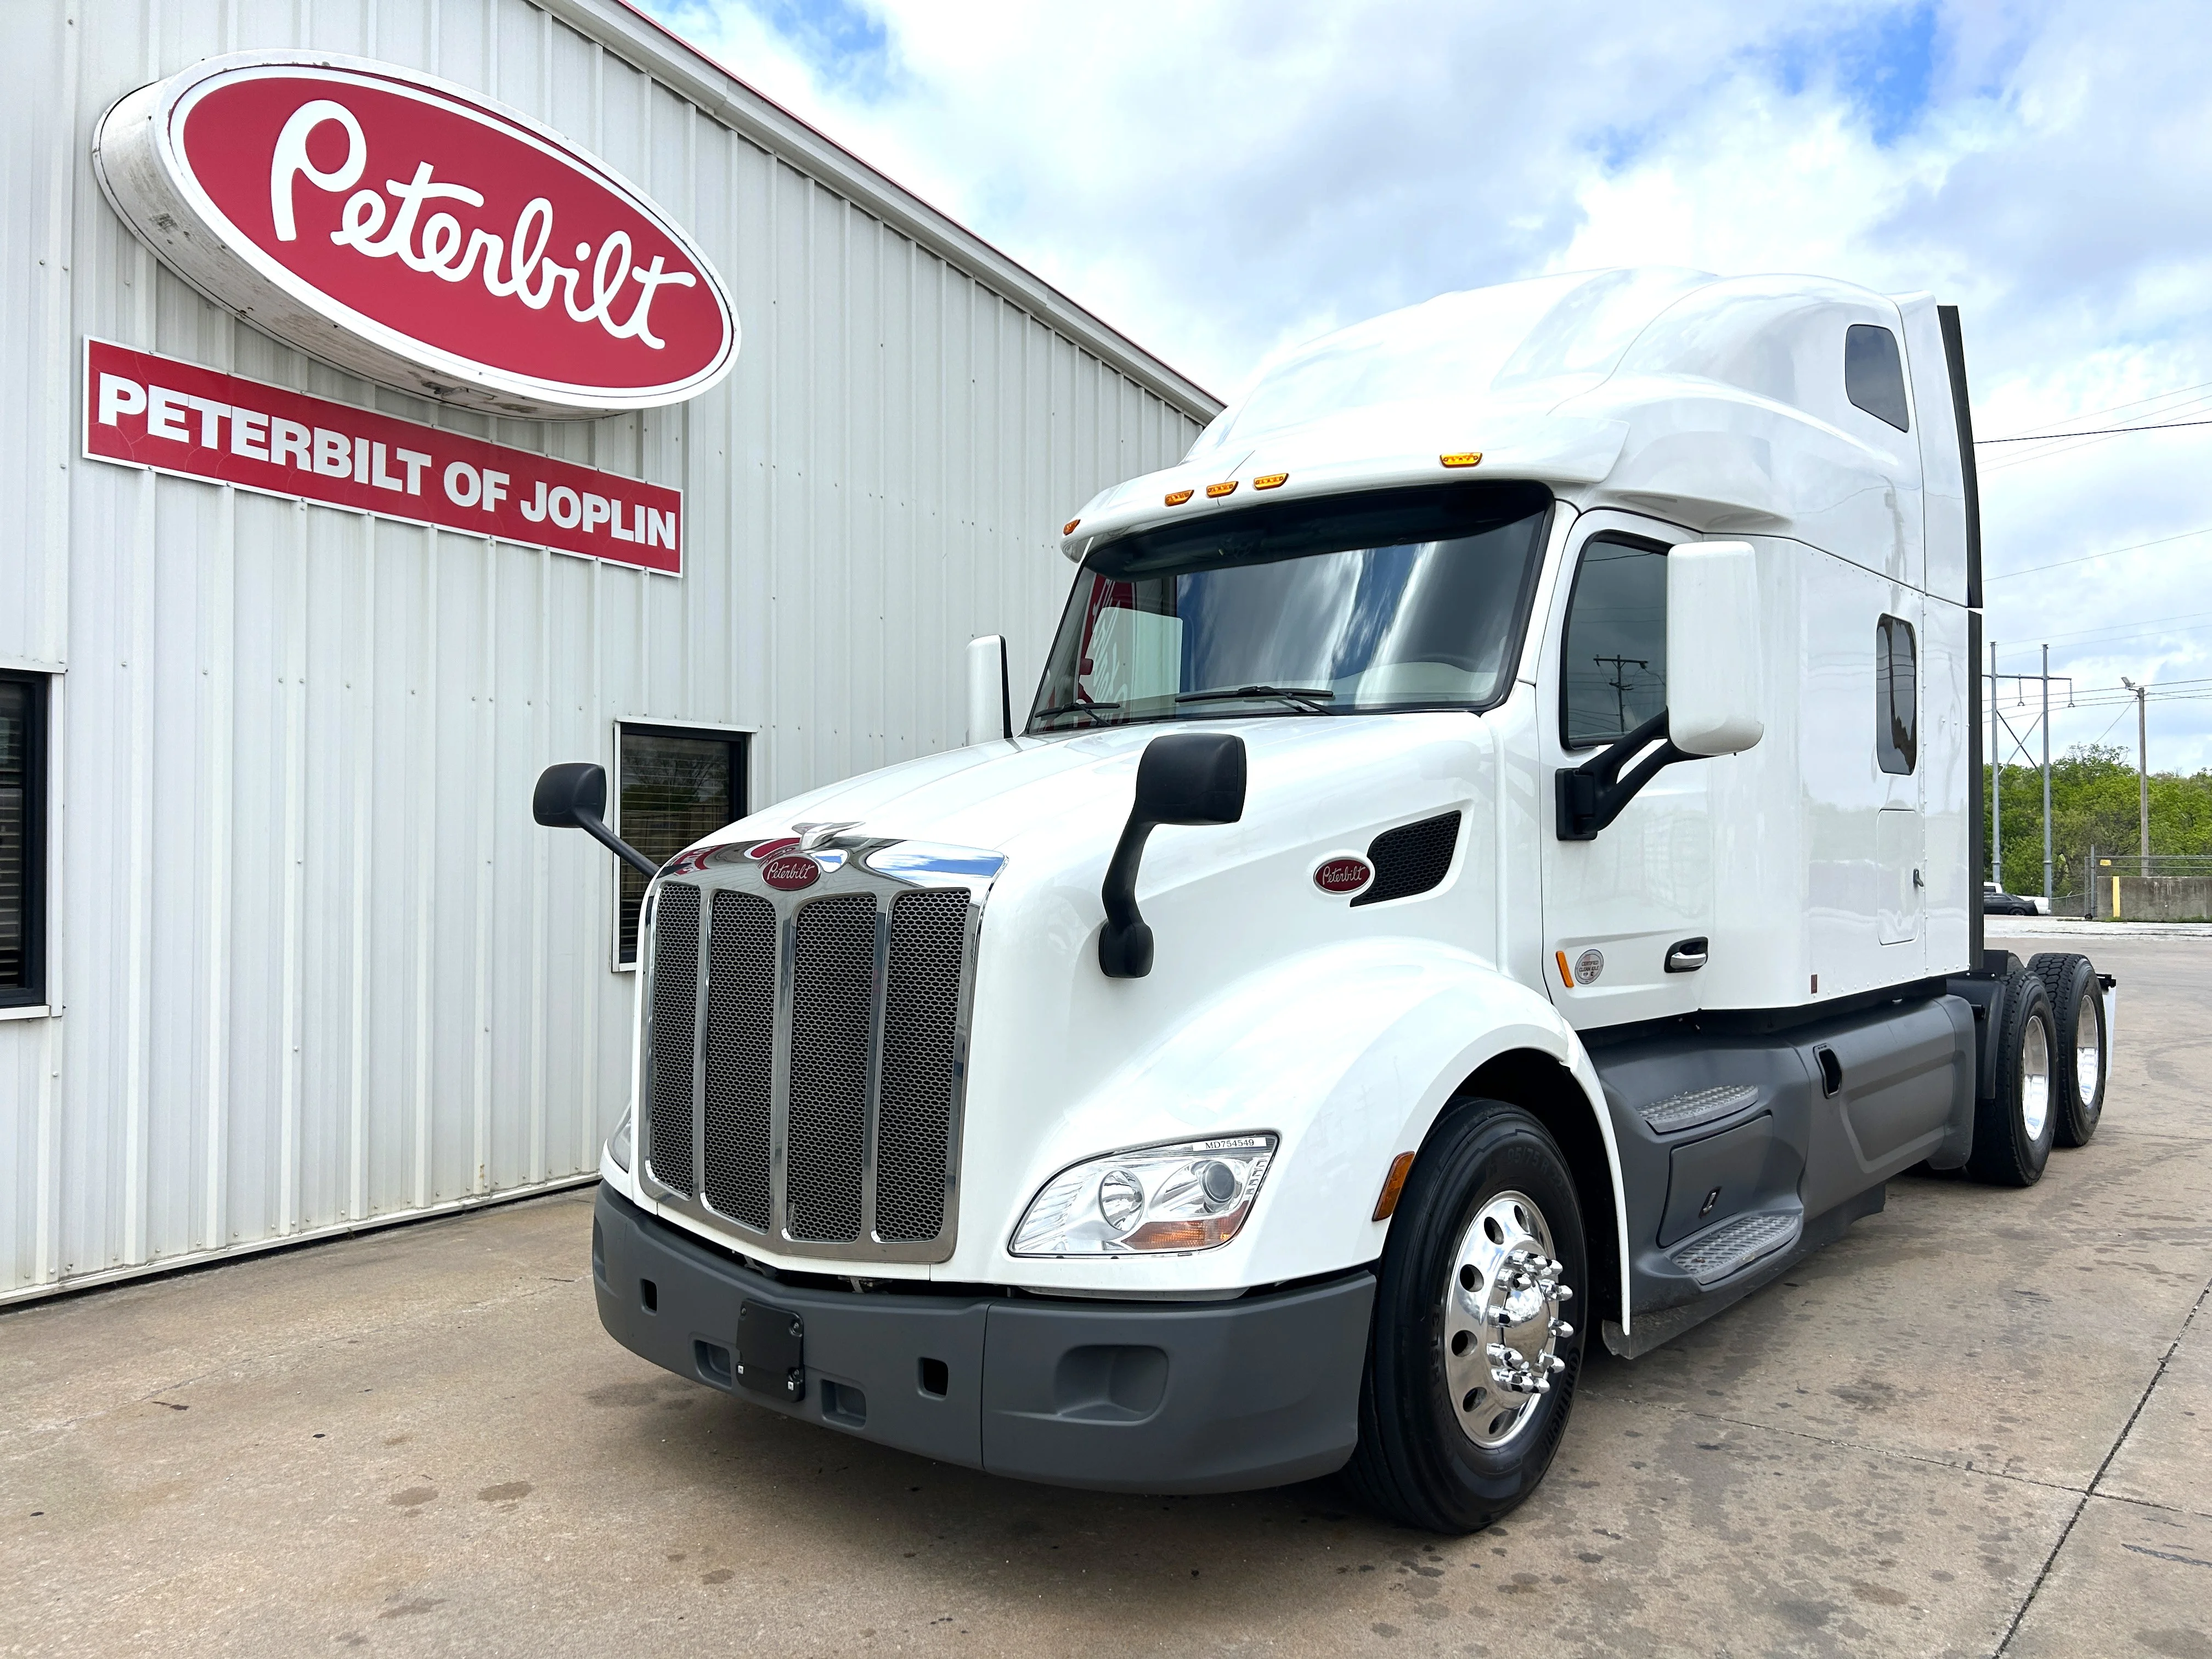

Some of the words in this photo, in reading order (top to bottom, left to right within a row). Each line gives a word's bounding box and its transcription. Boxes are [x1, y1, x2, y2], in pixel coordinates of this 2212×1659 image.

[271, 100, 696, 349] Peterbilt
[99, 373, 432, 495] PETERBILT
[444, 462, 510, 512] OF
[521, 481, 675, 550] JOPLIN
[767, 862, 815, 880] Peterbilt
[1323, 866, 1365, 885] Peterbilt
[1205, 1139, 1254, 1149] MD754549
